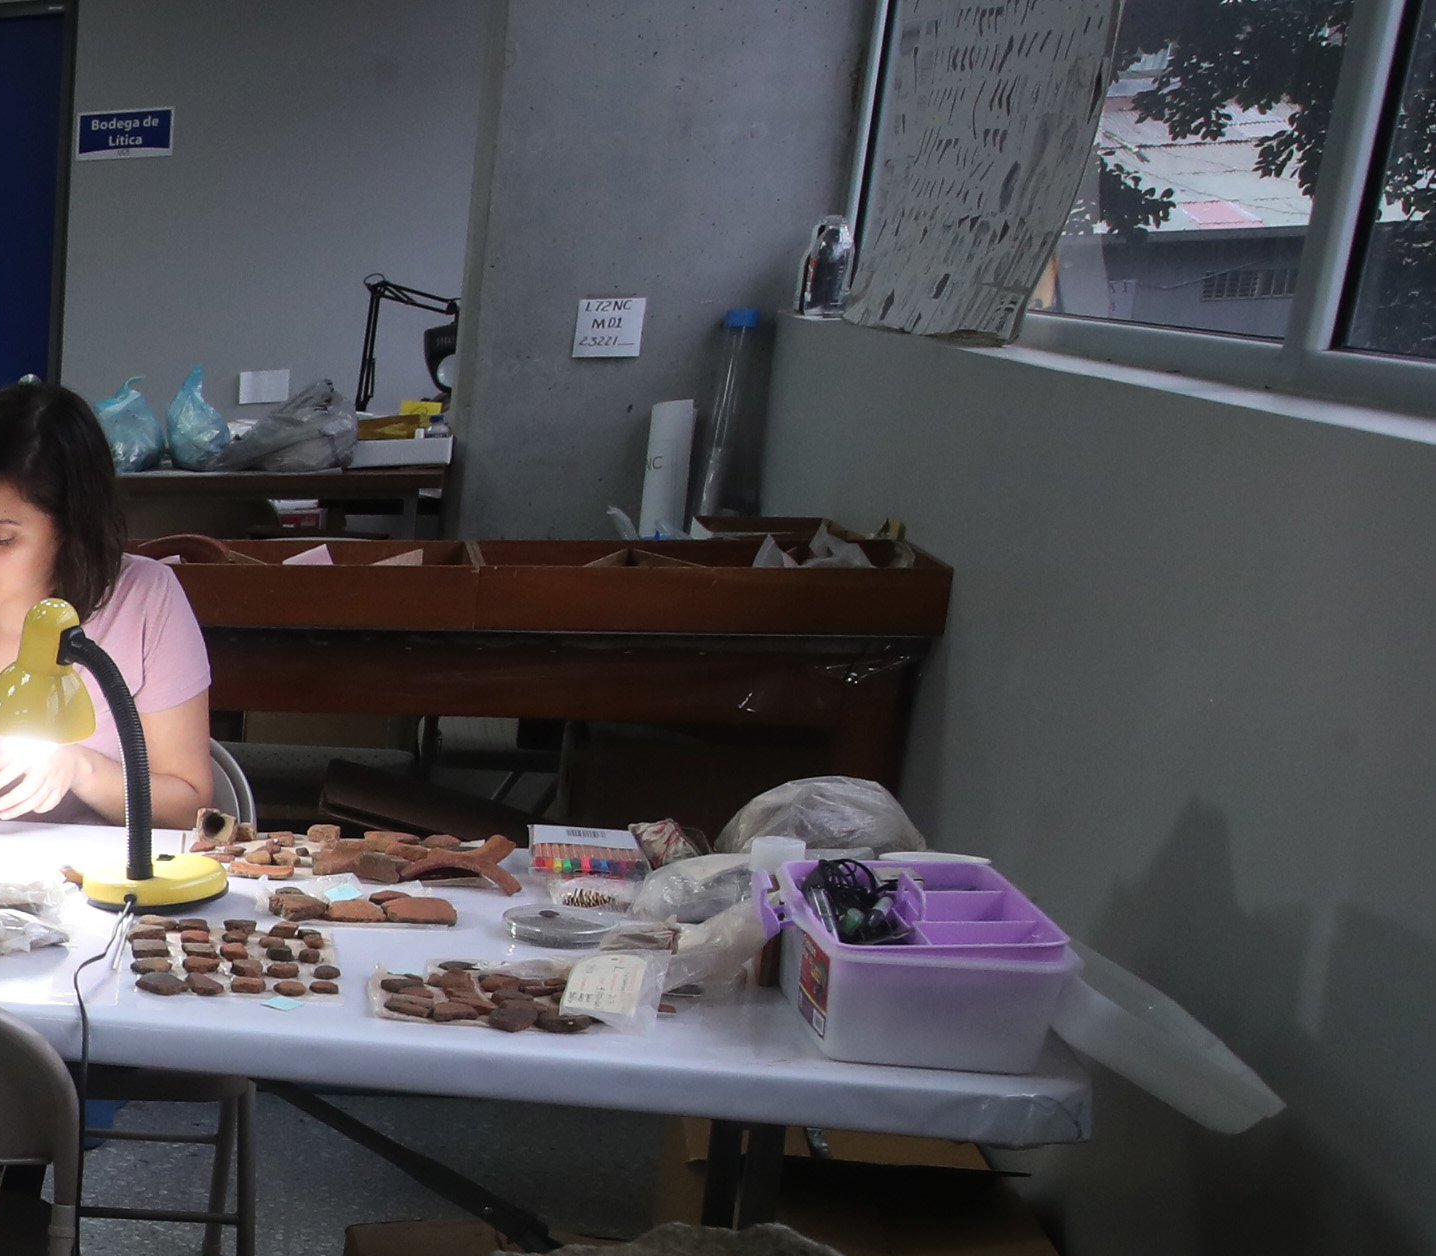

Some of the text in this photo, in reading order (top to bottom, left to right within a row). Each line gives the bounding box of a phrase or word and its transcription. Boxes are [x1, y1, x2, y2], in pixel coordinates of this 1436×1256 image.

[91, 115, 159, 132] Bodega de
[108, 133, 143, 147] Lítica
